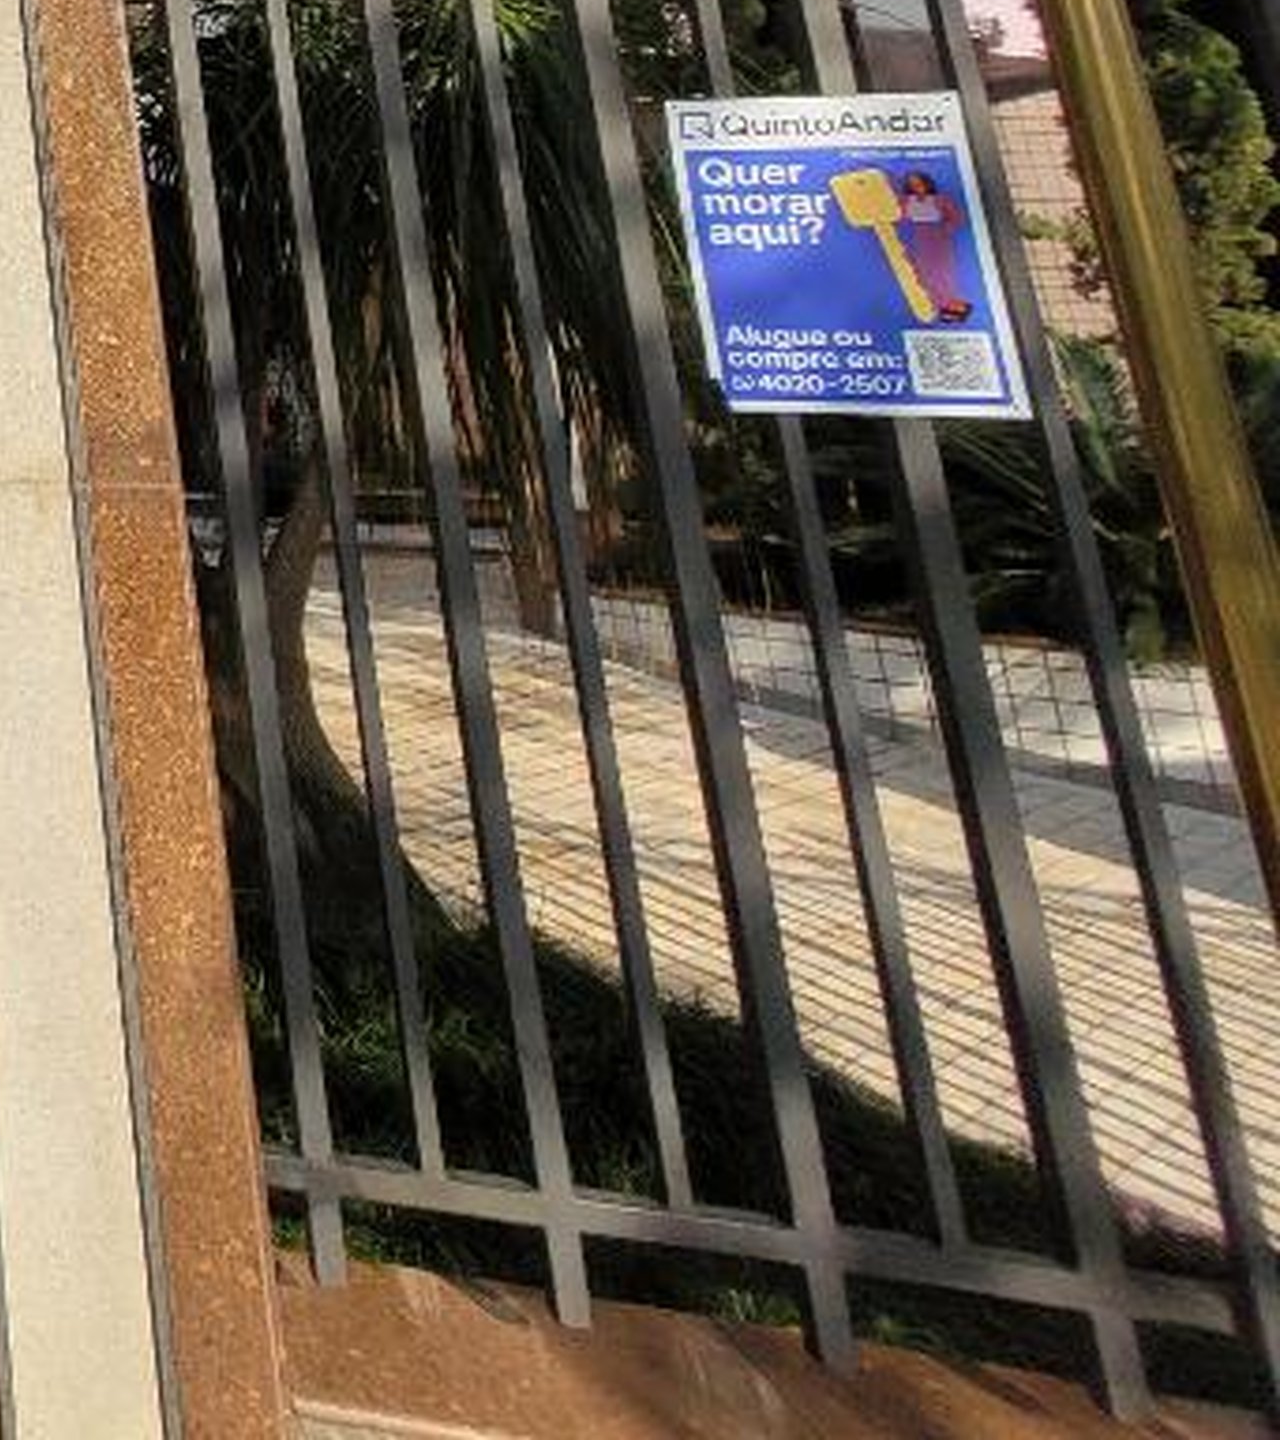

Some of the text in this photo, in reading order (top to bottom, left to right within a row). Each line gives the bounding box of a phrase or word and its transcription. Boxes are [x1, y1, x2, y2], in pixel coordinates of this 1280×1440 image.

[721, 109, 945, 137] QuintoAndar
[697, 160, 807, 188] Quer
[702, 190, 831, 217] morar
[708, 217, 826, 250] aqui?
[726, 325, 873, 349] Alugue ou
[727, 350, 904, 371] compre em:
